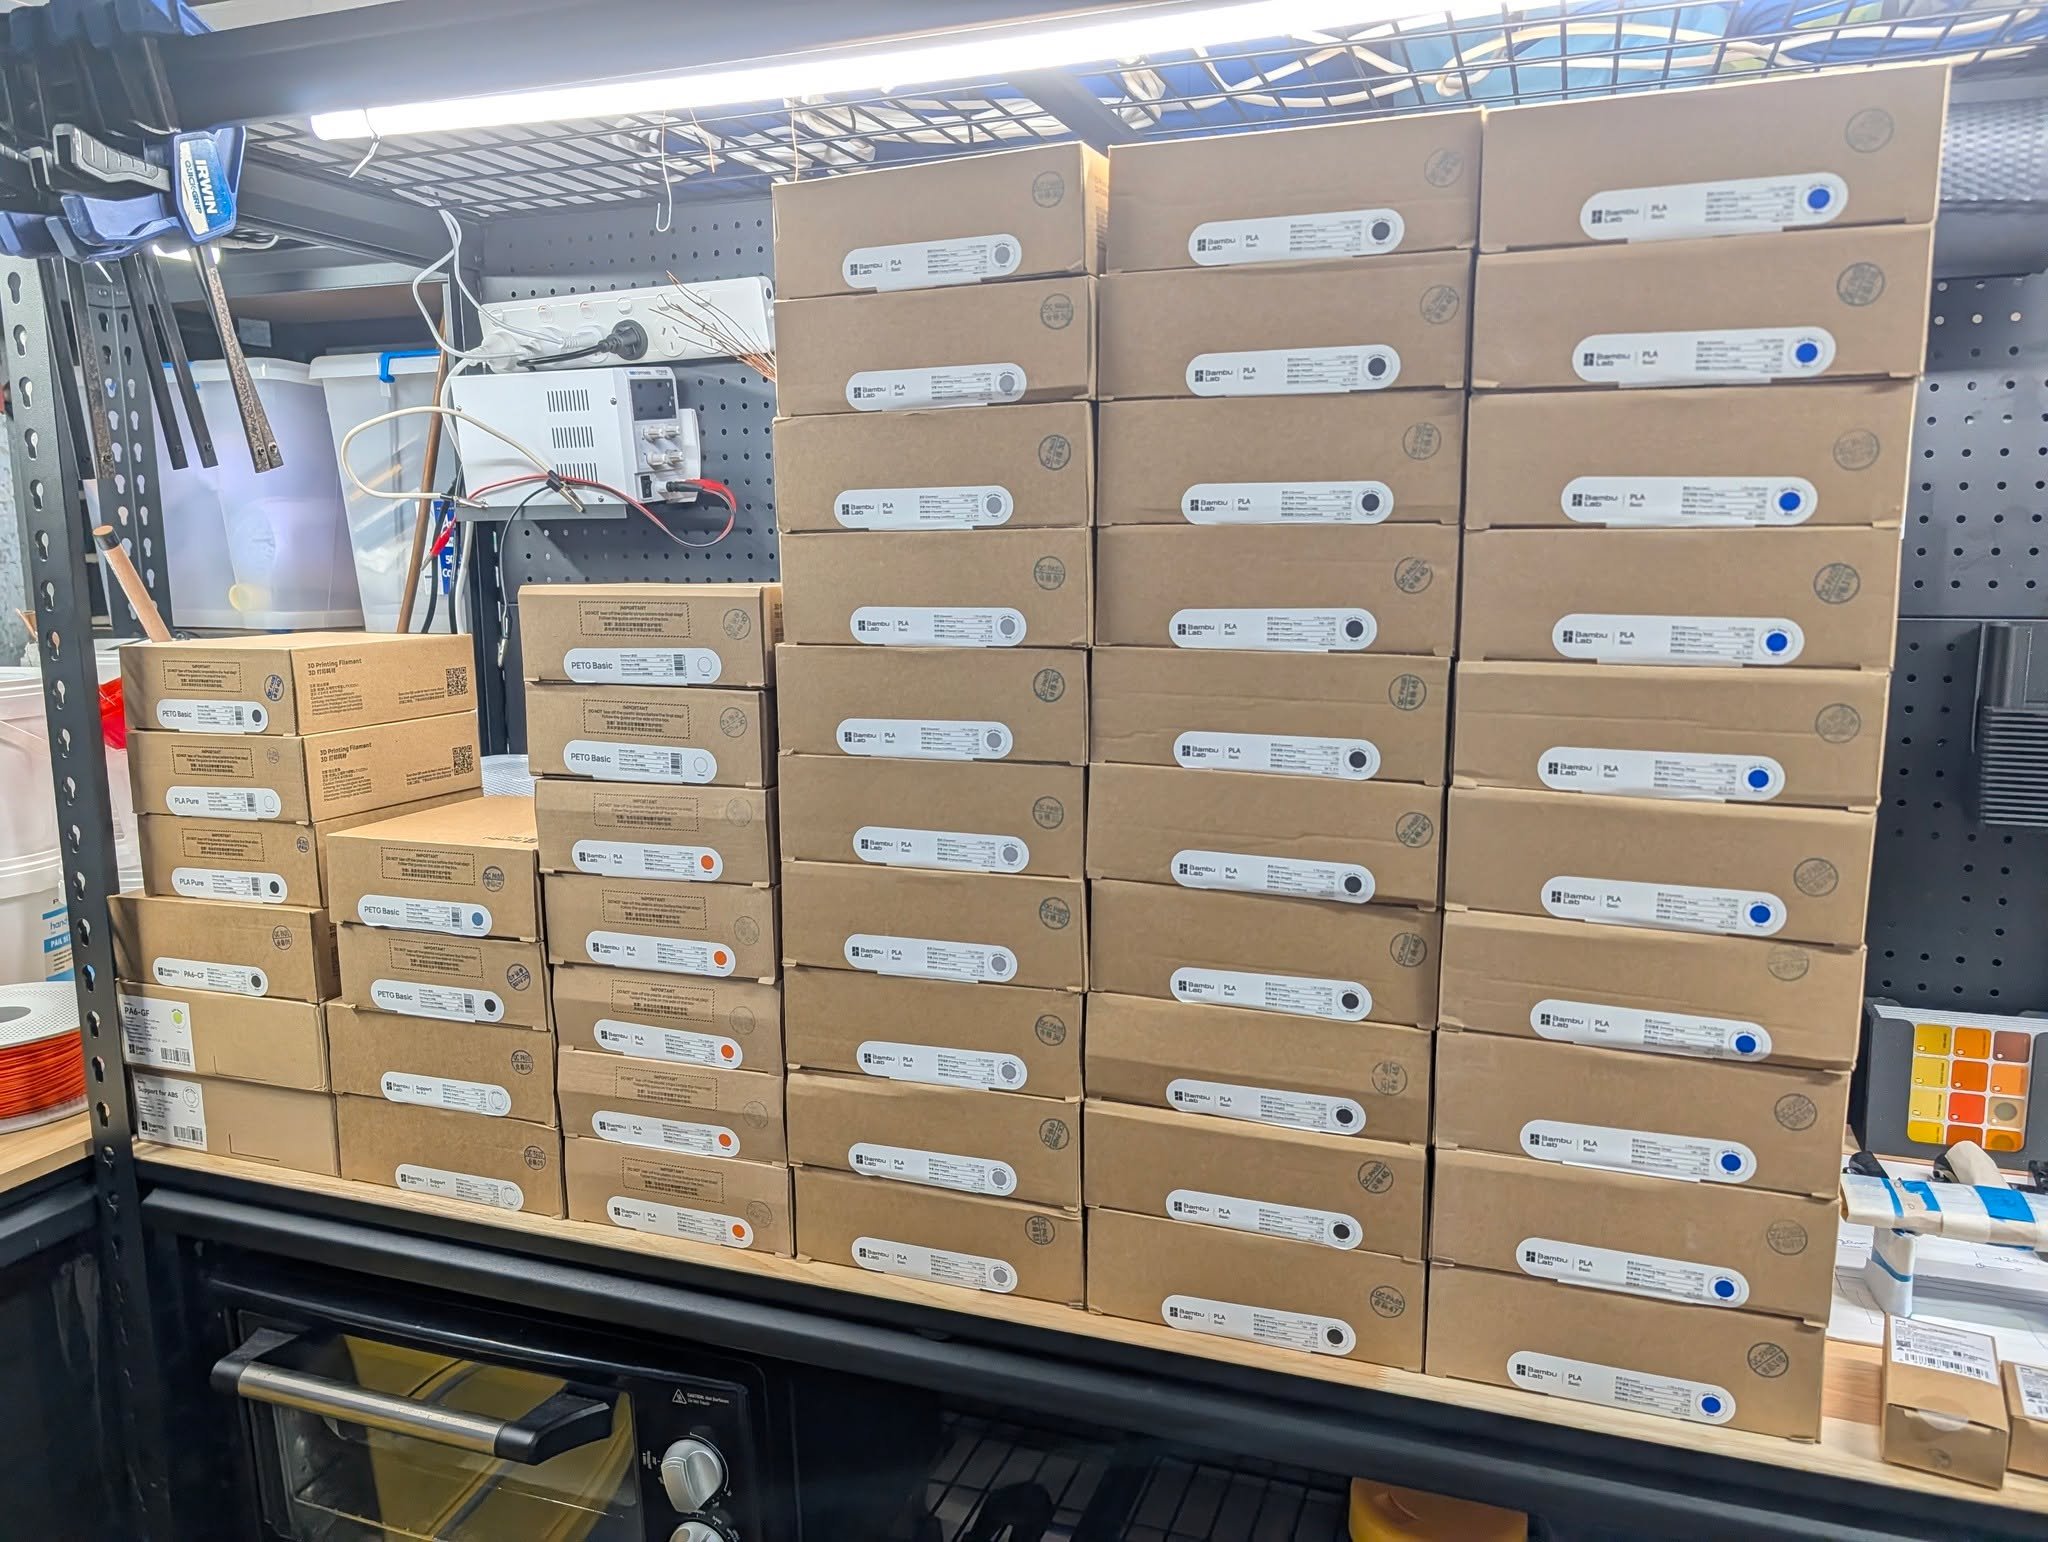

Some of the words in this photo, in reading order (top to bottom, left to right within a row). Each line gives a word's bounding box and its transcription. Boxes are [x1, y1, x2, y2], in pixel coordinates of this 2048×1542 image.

[195, 159, 218, 214] IRWIN
[1207, 238, 1236, 246] Bambu
[1246, 235, 1259, 243] PLA
[890, 259, 902, 267] PLA
[1205, 369, 1233, 377] Bambu
[894, 383, 906, 391] PLA
[315, 660, 338, 669] Printing
[338, 658, 362, 667] Filament
[571, 661, 592, 670] PETG
[592, 661, 613, 670] Basic
[162, 710, 177, 718] PETG
[327, 746, 349, 755] Printing
[349, 742, 372, 751] Filament
[1192, 746, 1219, 754] Bambu
[570, 753, 591, 762] PETG
[591, 754, 612, 763] Basic
[1560, 763, 1592, 772] Bambu
[1604, 764, 1619, 773] PLA
[1560, 769, 1577, 777] Lab
[174, 797, 185, 805] PLA
[869, 840, 894, 848] Bambu
[901, 841, 913, 849] PLA
[1189, 864, 1216, 873] Bambu
[1225, 866, 1238, 874] PLA
[190, 879, 205, 887] Pure
[1564, 892, 1595, 902] Bambu
[1606, 895, 1622, 903] PLA
[1564, 898, 1581, 906] Lab
[364, 906, 382, 914] PETG
[382, 907, 400, 916] Basic
[860, 947, 884, 956] Bambu
[891, 949, 903, 957] PLA
[1187, 980, 1215, 990] Bambu
[1224, 984, 1237, 992] PLA
[377, 990, 395, 998] PETG
[395, 992, 413, 1001] Basic
[125, 1007, 150, 1016] PA6-GF
[1552, 1015, 1584, 1026] Bambu
[1595, 1019, 1610, 1028] PLA
[1552, 1022, 1569, 1030] Lab
[872, 1054, 896, 1063] Bambu
[902, 1056, 914, 1064] PLA
[138, 1086, 158, 1097] Support
[168, 1090, 179, 1099] ABS
[1184, 1092, 1210, 1101] Bambu
[1219, 1095, 1232, 1103] PLA
[1541, 1134, 1573, 1146] Bambu
[1583, 1139, 1598, 1148] PLA
[864, 1156, 887, 1165] Bambu
[894, 1159, 906, 1167] PLA
[1183, 1203, 1209, 1212] Bambu
[1218, 1207, 1231, 1215] PLA
[867, 1249, 890, 1258] Bambu
[897, 1254, 908, 1262] PLA
[1537, 1253, 1568, 1264] Bambu
[1537, 1259, 1554, 1267] Lab
[1579, 1259, 1594, 1268] PLA
[1179, 1308, 1205, 1318] Bambu
[1214, 1313, 1226, 1321] PLA
[1527, 1366, 1558, 1378] Bambu
[1527, 1373, 1543, 1381] Lab
[1568, 1373, 1582, 1382] PLA
